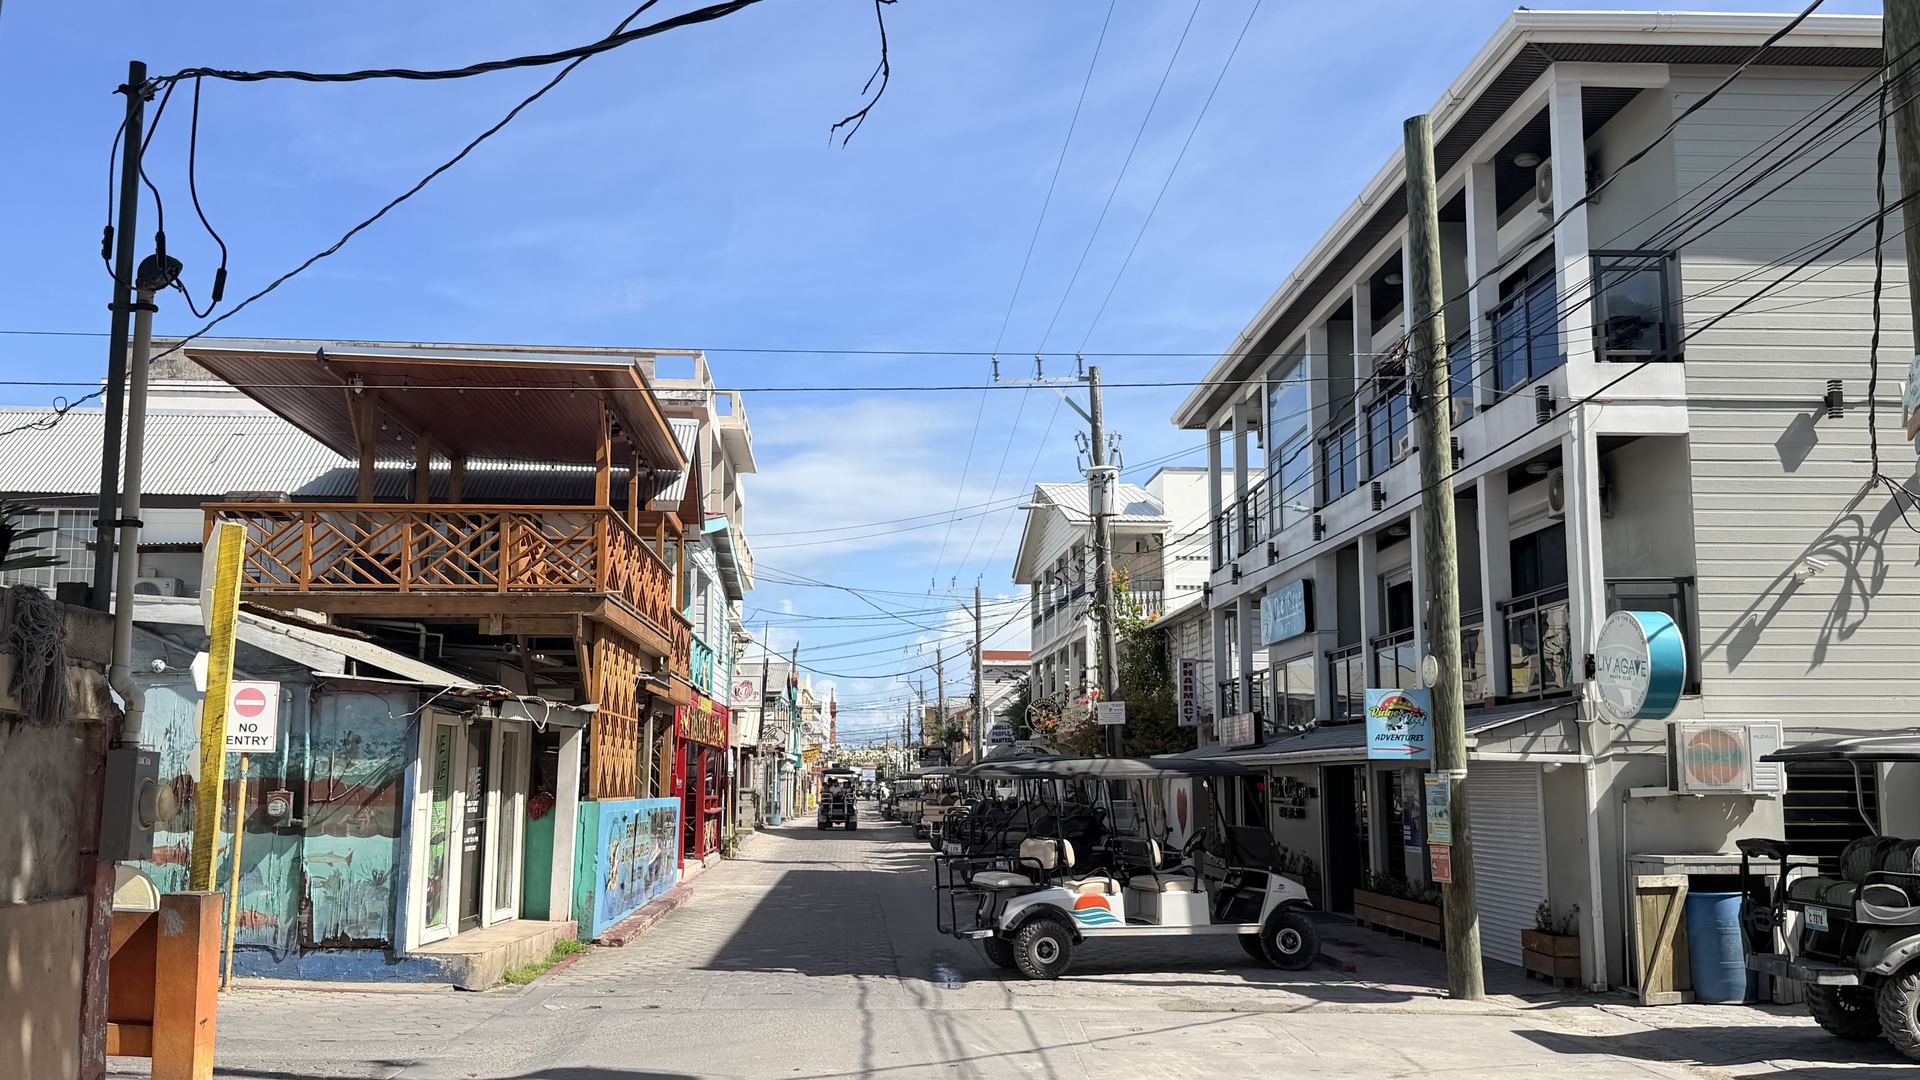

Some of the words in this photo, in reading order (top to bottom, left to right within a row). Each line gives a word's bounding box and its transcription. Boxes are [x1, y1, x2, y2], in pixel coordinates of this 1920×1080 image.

[1597, 656, 1612, 671] LIV
[1614, 655, 1647, 678] AGAVE
[1183, 662, 1193, 722] PHARMACY
[1369, 706, 1398, 719] Ridge
[239, 723, 258, 733] NO
[226, 735, 269, 746] ENTRY
[1375, 734, 1425, 742] ADVENTURES
